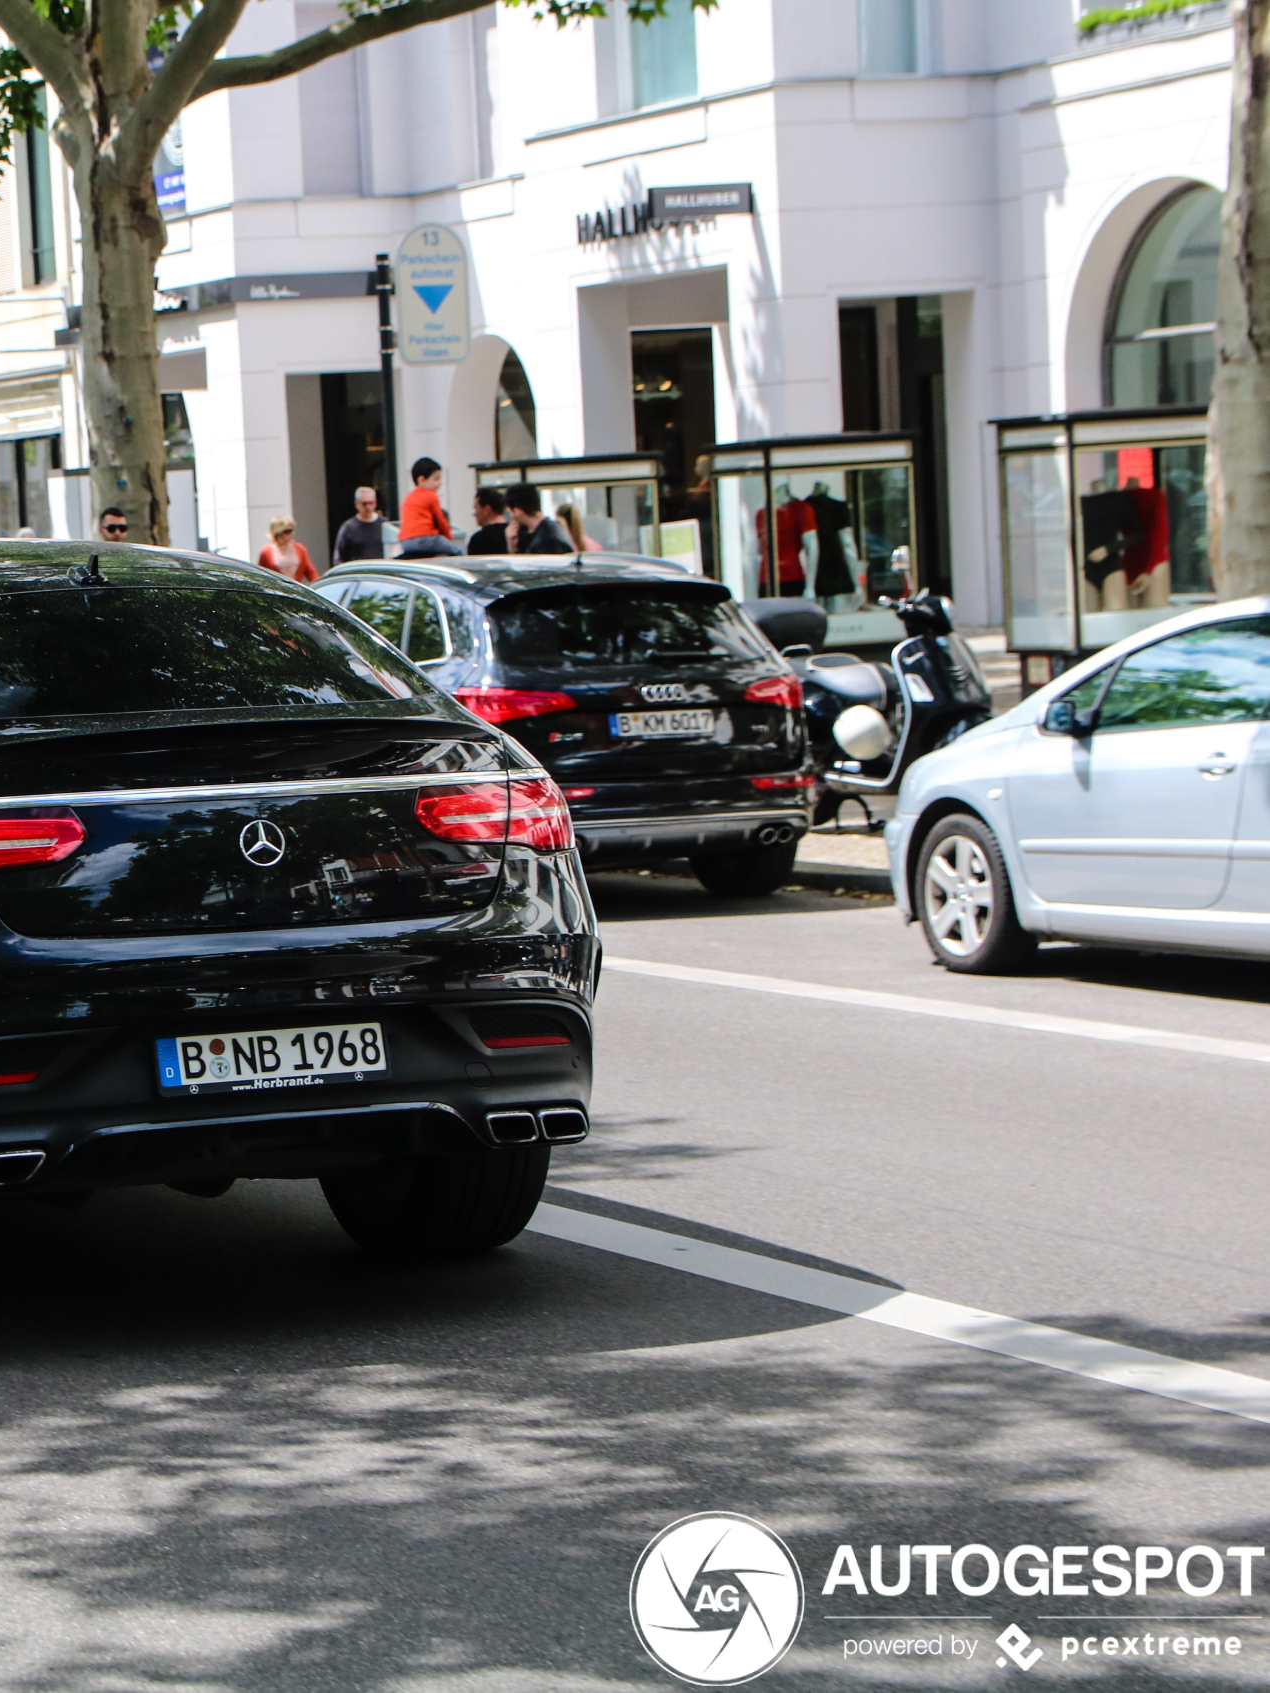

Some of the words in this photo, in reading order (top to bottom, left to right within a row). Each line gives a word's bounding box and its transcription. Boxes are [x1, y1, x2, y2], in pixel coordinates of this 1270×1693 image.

[422, 231, 440, 246] 13
[410, 269, 455, 279] automat
[408, 335, 462, 345] Parkschein
[620, 716, 631, 733] B
[670, 711, 711, 730] 6017
[181, 1041, 207, 1079] B
[231, 1035, 281, 1076] NB
[290, 1027, 381, 1071] 1968
[165, 1067, 175, 1078] D
[232, 1075, 324, 1091] www.Herbrand.de
